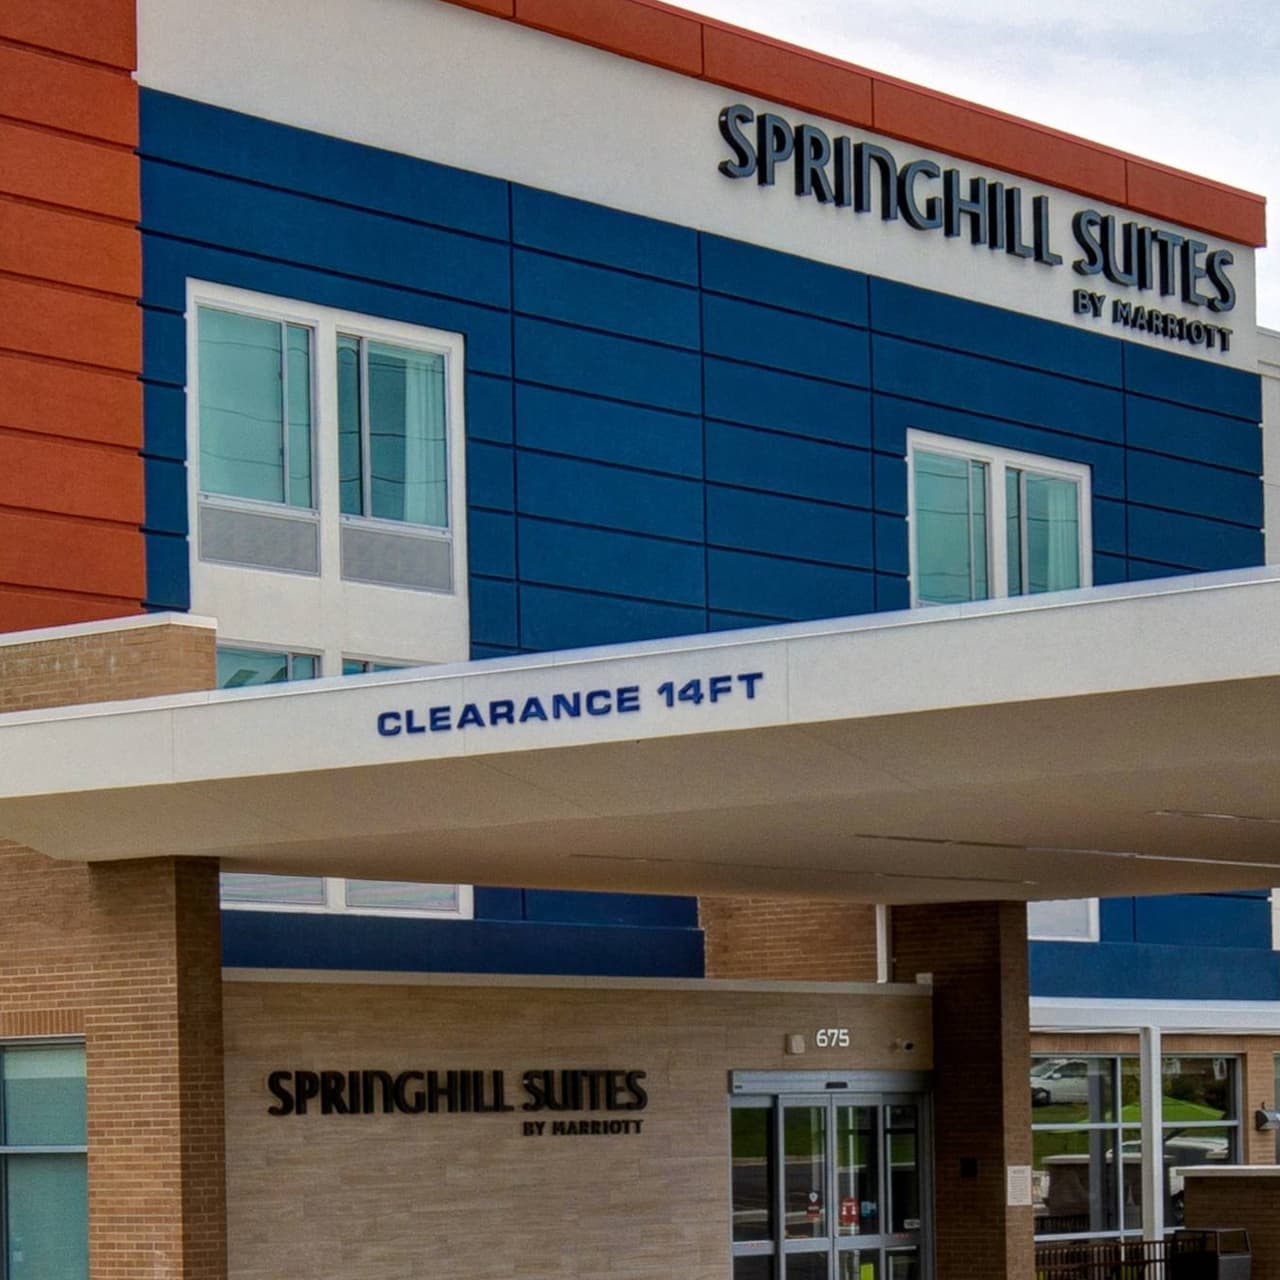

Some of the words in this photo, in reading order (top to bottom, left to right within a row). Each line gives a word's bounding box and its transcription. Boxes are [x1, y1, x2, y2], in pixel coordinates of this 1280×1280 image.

[718, 104, 1063, 266] SPRINGHILL
[1072, 209, 1237, 312] SUITES
[1073, 288, 1107, 318] BY
[1111, 298, 1233, 352] MARRIOTT
[377, 685, 640, 737] CLEARANCE
[657, 672, 764, 708] 14FT
[816, 1028, 850, 1047] 675
[267, 1069, 515, 1116] SPRINGHILL
[522, 1069, 648, 1112] SUITES
[523, 1121, 546, 1137] BY
[552, 1119, 644, 1136] MARRIOTT
